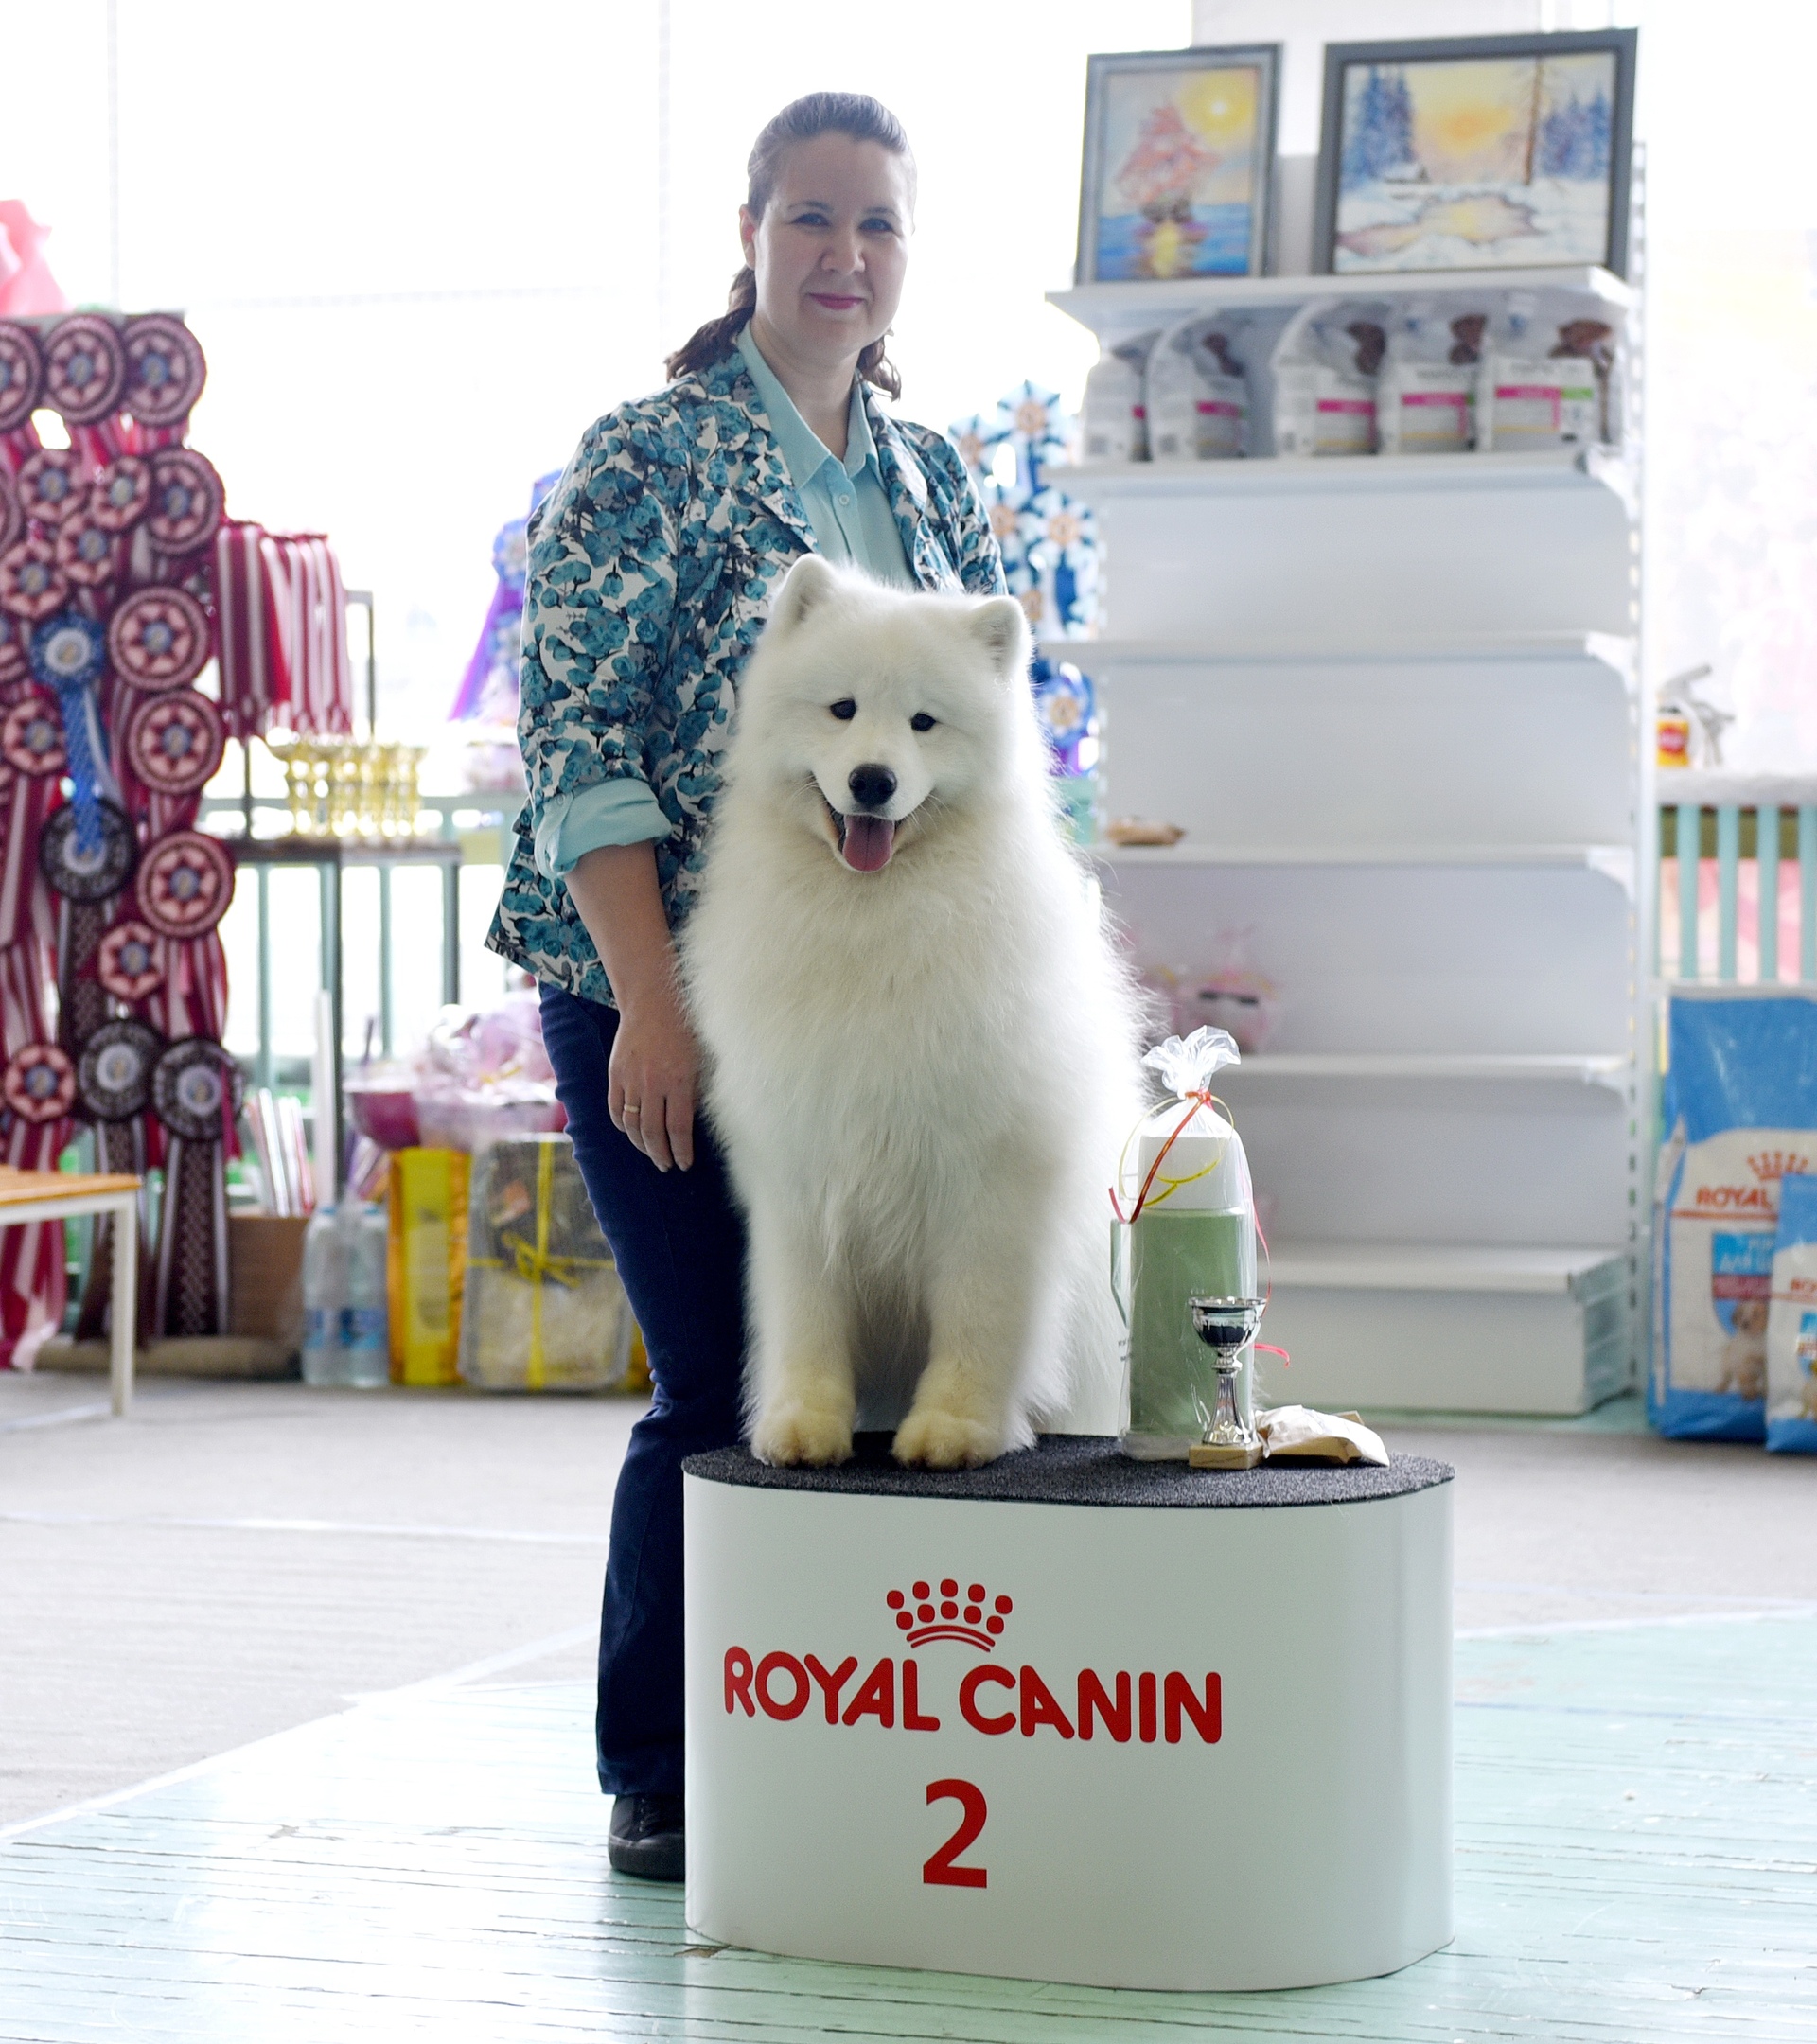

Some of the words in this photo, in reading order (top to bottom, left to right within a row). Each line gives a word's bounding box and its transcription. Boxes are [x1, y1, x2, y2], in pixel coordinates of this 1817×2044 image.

[1696, 1185, 1773, 1208] ROYAL
[723, 1645, 942, 1733] ROYAL
[958, 1664, 1223, 1745] CANIN
[923, 1778, 988, 1889] 2
